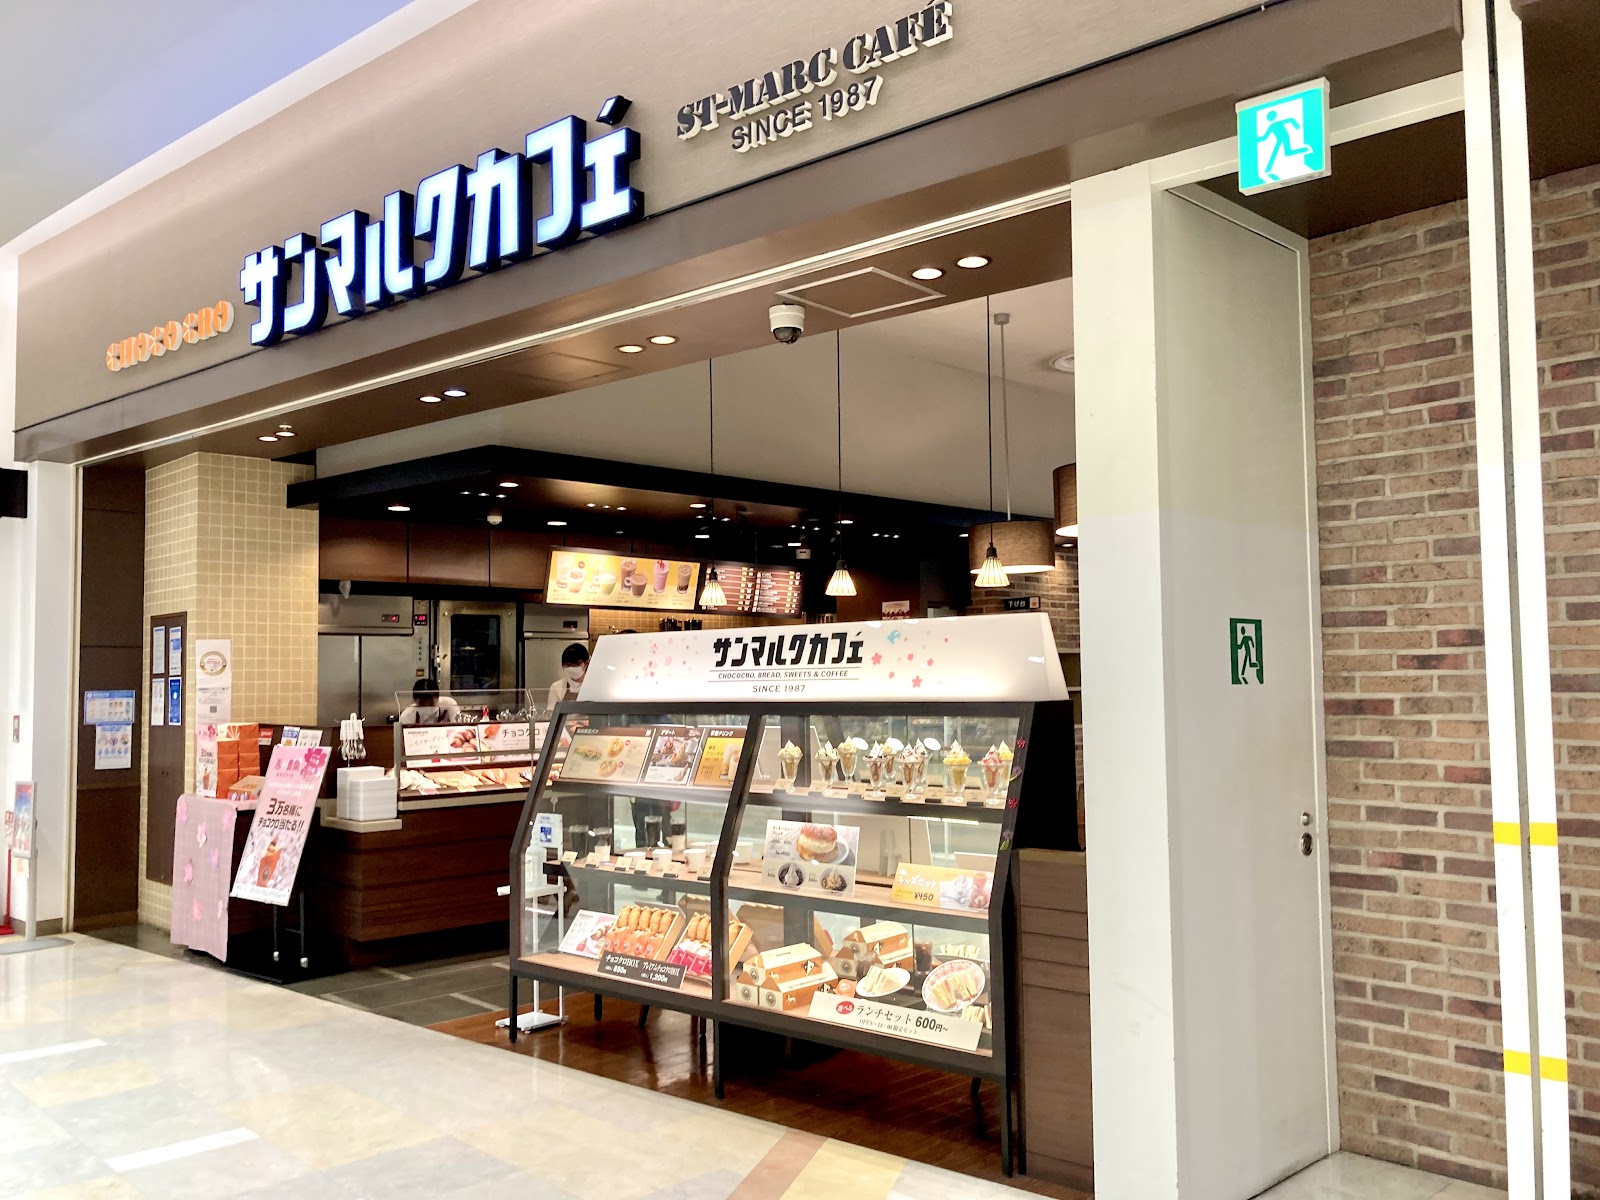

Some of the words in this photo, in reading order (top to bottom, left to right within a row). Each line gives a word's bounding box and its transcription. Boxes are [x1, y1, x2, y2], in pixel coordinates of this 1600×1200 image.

[677, 47, 837, 140] ST-MARC
[843, 0, 953, 75] CAFÉ
[732, 102, 812, 152] SINCE
[819, 75, 883, 121] 1987
[758, 671, 782, 679] BREAD,
[266, 797, 303, 816] 3万名様に
[914, 891, 934, 901] ¥450
[857, 1005, 912, 1025] ランチセット
